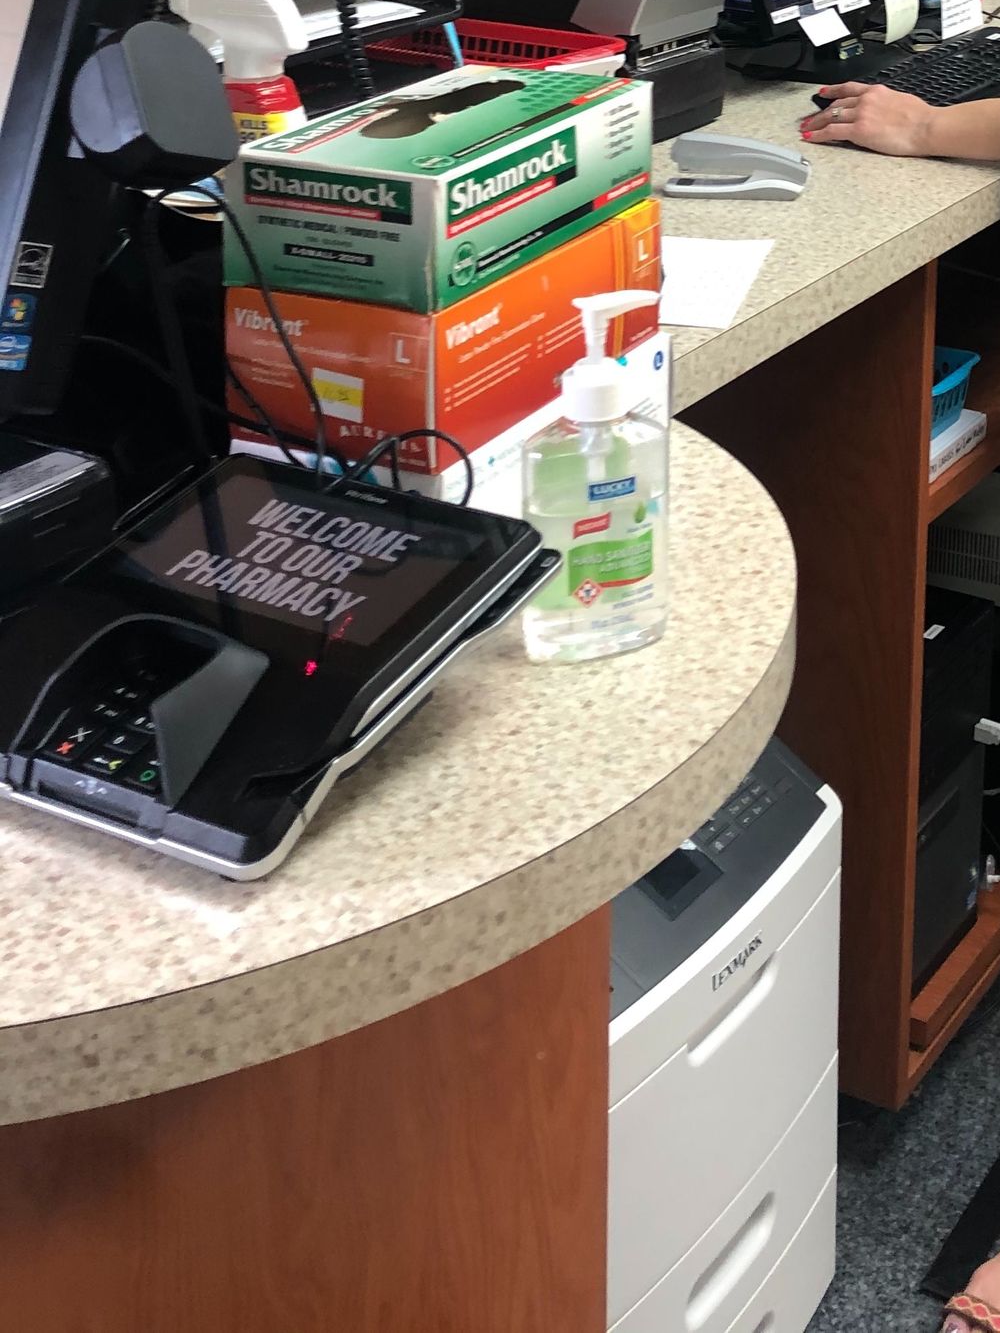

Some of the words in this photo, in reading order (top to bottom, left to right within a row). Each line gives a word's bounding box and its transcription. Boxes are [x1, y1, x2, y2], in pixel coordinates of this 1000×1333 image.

[250, 168, 398, 208] Shamrock
[450, 139, 568, 215] Shamrock
[395, 339, 411, 364] L
[236, 531, 293, 564] TO
[281, 544, 364, 584] OUR
[247, 499, 422, 562] WELCOME
[166, 550, 368, 622] PHARMACY
[712, 934, 762, 992] LEXMARK
